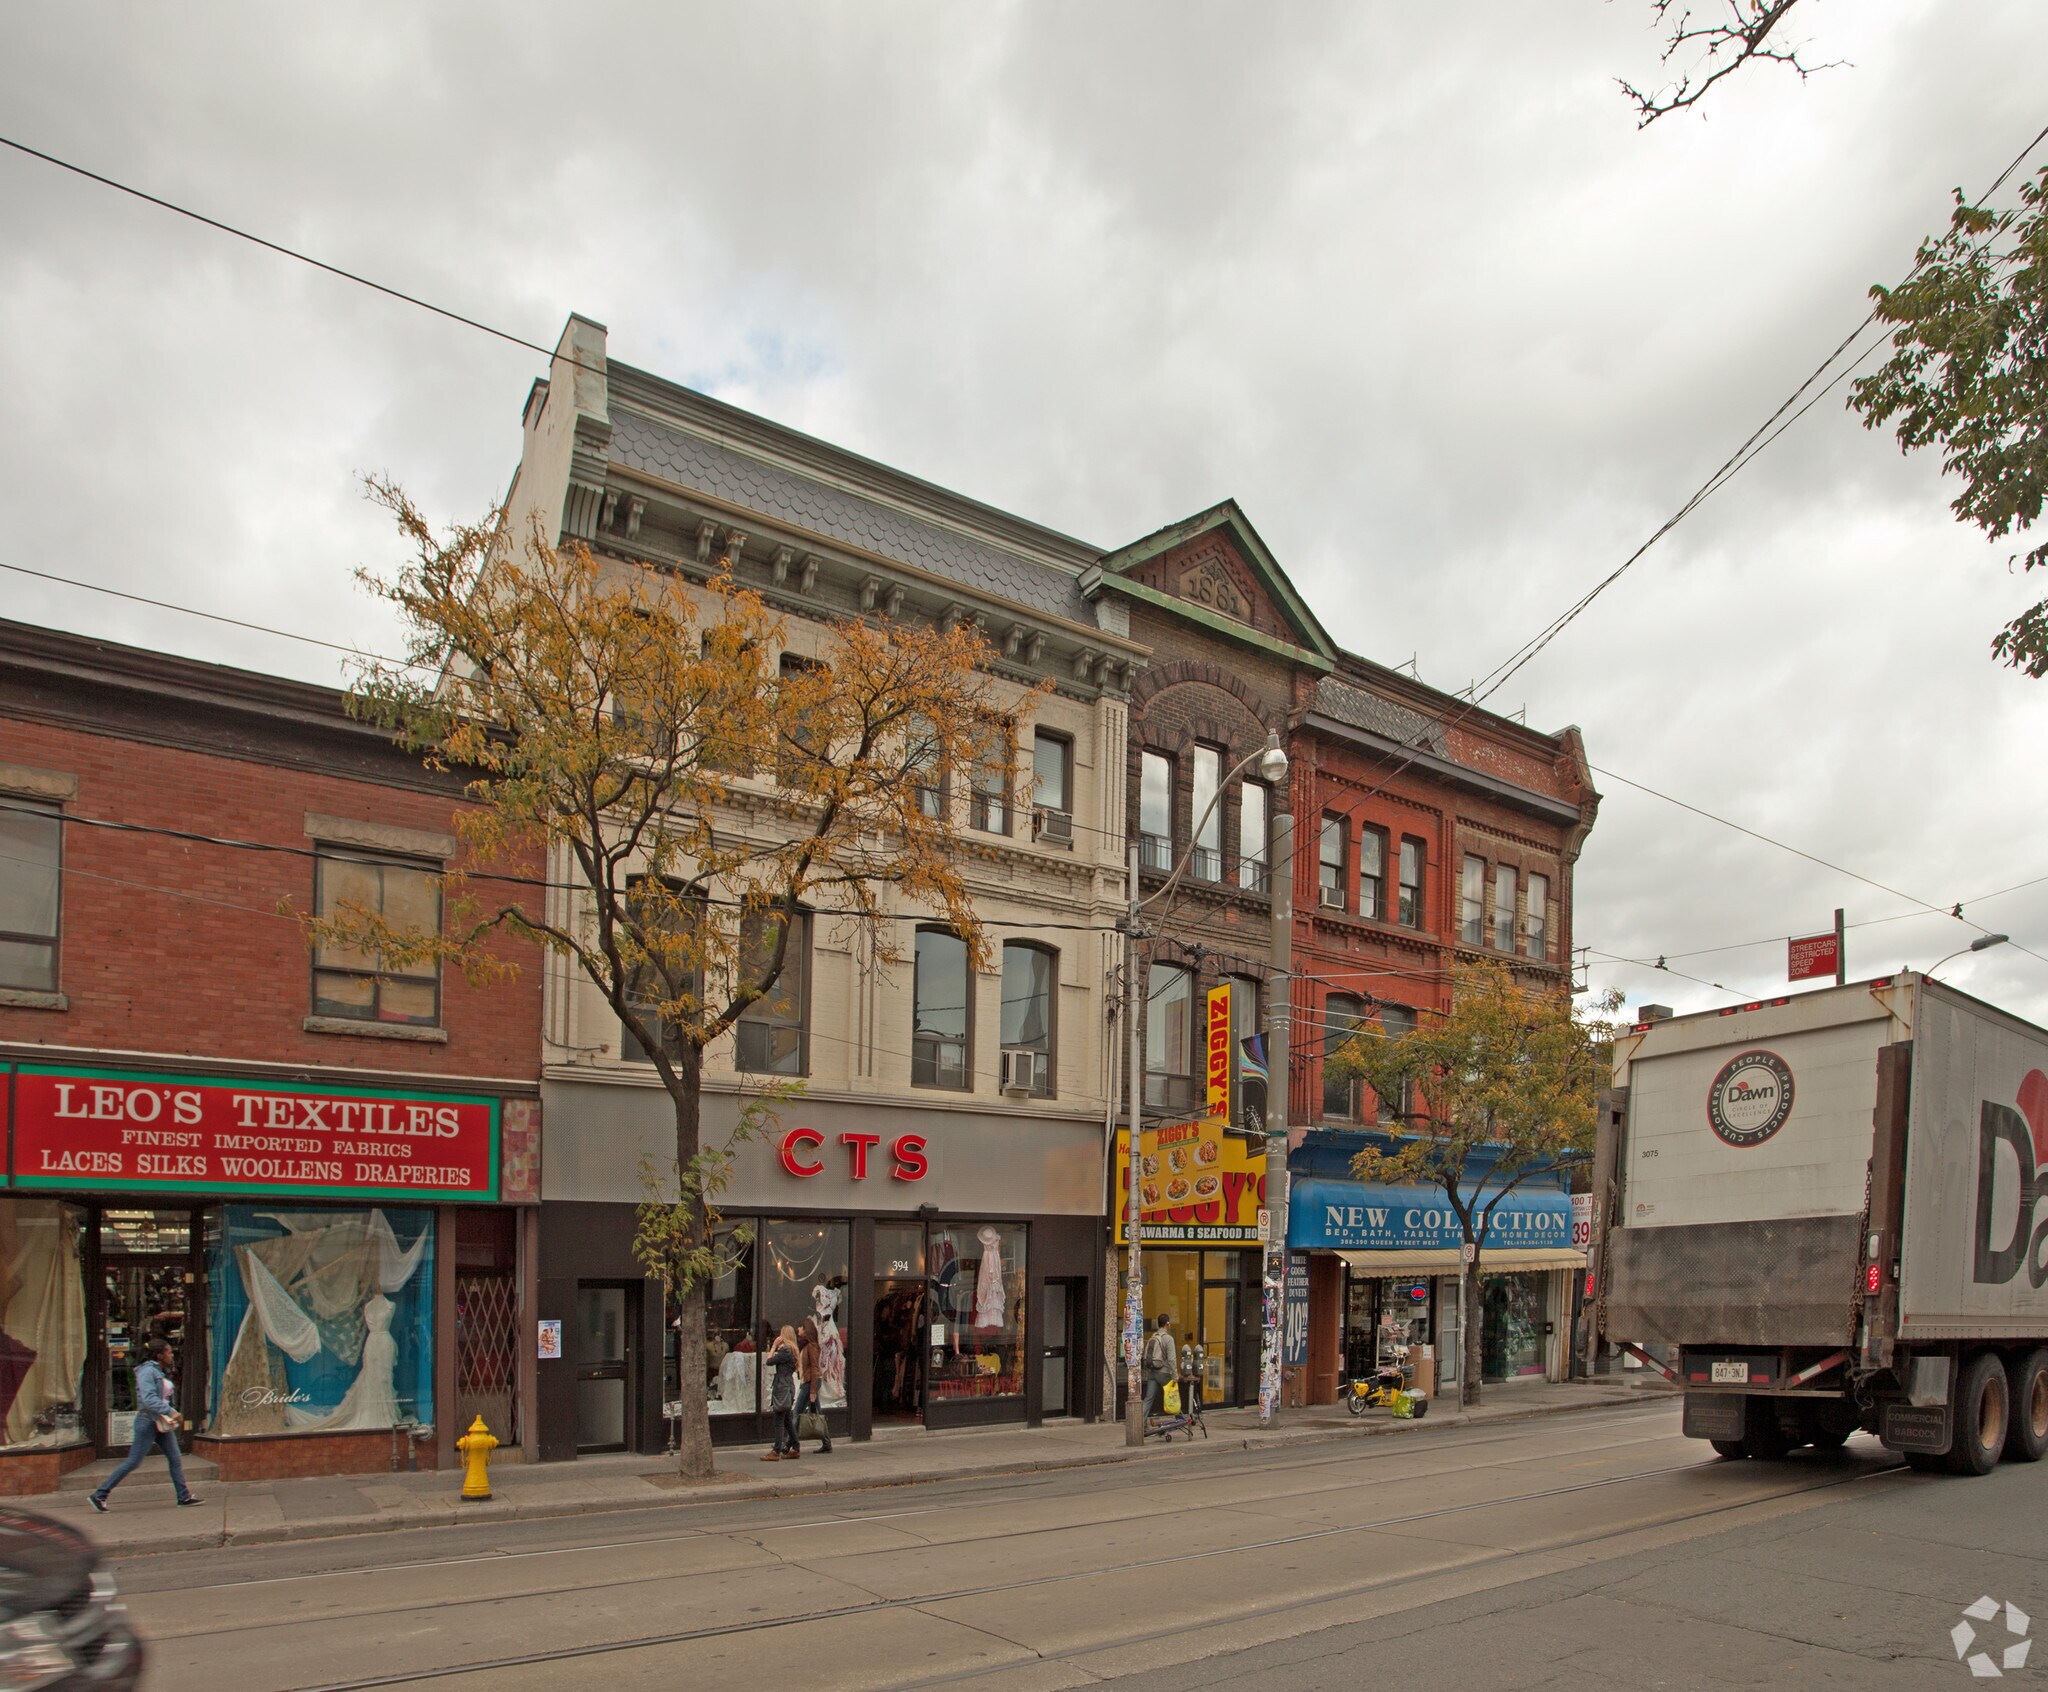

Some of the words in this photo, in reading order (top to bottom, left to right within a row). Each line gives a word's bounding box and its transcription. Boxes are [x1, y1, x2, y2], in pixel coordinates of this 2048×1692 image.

[1188, 575, 1241, 616] 1881
[1791, 939, 1837, 954] STREETCARS
[1791, 947, 1835, 960] RESTRICTED
[1791, 958, 1815, 969] SPEED
[1791, 966, 1810, 976] ZONE
[1209, 995, 1229, 1118] ZIGGY'S
[1731, 1055, 1775, 1071] PEOPLE
[1728, 1086, 1775, 1103] Dawn
[54, 1084, 203, 1124] LEO'S
[232, 1094, 460, 1139] TEXTILES
[1711, 1083, 1745, 1142] CUSTOMERS
[1732, 1104, 1756, 1113] CIRCLE
[1757, 1075, 1790, 1139] PRODUCTS
[1728, 1109, 1772, 1119] EXCELLENCE
[1157, 1120, 1200, 1146] ZIGGY'S
[121, 1129, 203, 1148] FINEST
[213, 1134, 323, 1154] IMPORTED
[332, 1140, 412, 1158] FABRICS
[1118, 1143, 1131, 1155] Ha
[778, 1127, 929, 1182] CTS
[1641, 1149, 1659, 1159] 3075
[40, 1149, 123, 1173] LACES
[137, 1154, 208, 1176] SILKS
[222, 1157, 343, 1182] WOOLLENS
[354, 1163, 471, 1186] DRAPERIES
[1325, 1206, 1390, 1228] NEW
[1404, 1209, 1567, 1231] COLECTION
[1124, 1226, 1184, 1239] SAWARMA
[1187, 1228, 1194, 1239] &
[1197, 1228, 1241, 1239] SEAFOOD
[1244, 1228, 1258, 1239] HO
[1325, 1229, 1354, 1238] BED,
[1362, 1229, 1396, 1238] BATH,
[1404, 1230, 1438, 1238] TABLE
[1502, 1231, 1529, 1239] HOME
[1535, 1231, 1566, 1239] DECOR
[1572, 1221, 1590, 1245] 39
[892, 1260, 909, 1272] 394
[1291, 1255, 1307, 1265] WHITE
[1290, 1266, 1307, 1276] GOOSE
[1287, 1277, 1309, 1286] FEATHER
[1289, 1288, 1307, 1297] DUVETS
[241, 1386, 312, 1410] Bride's
[1888, 1413, 1943, 1425] COMMERCIAL
[1894, 1427, 1937, 1439] BABCOCK
